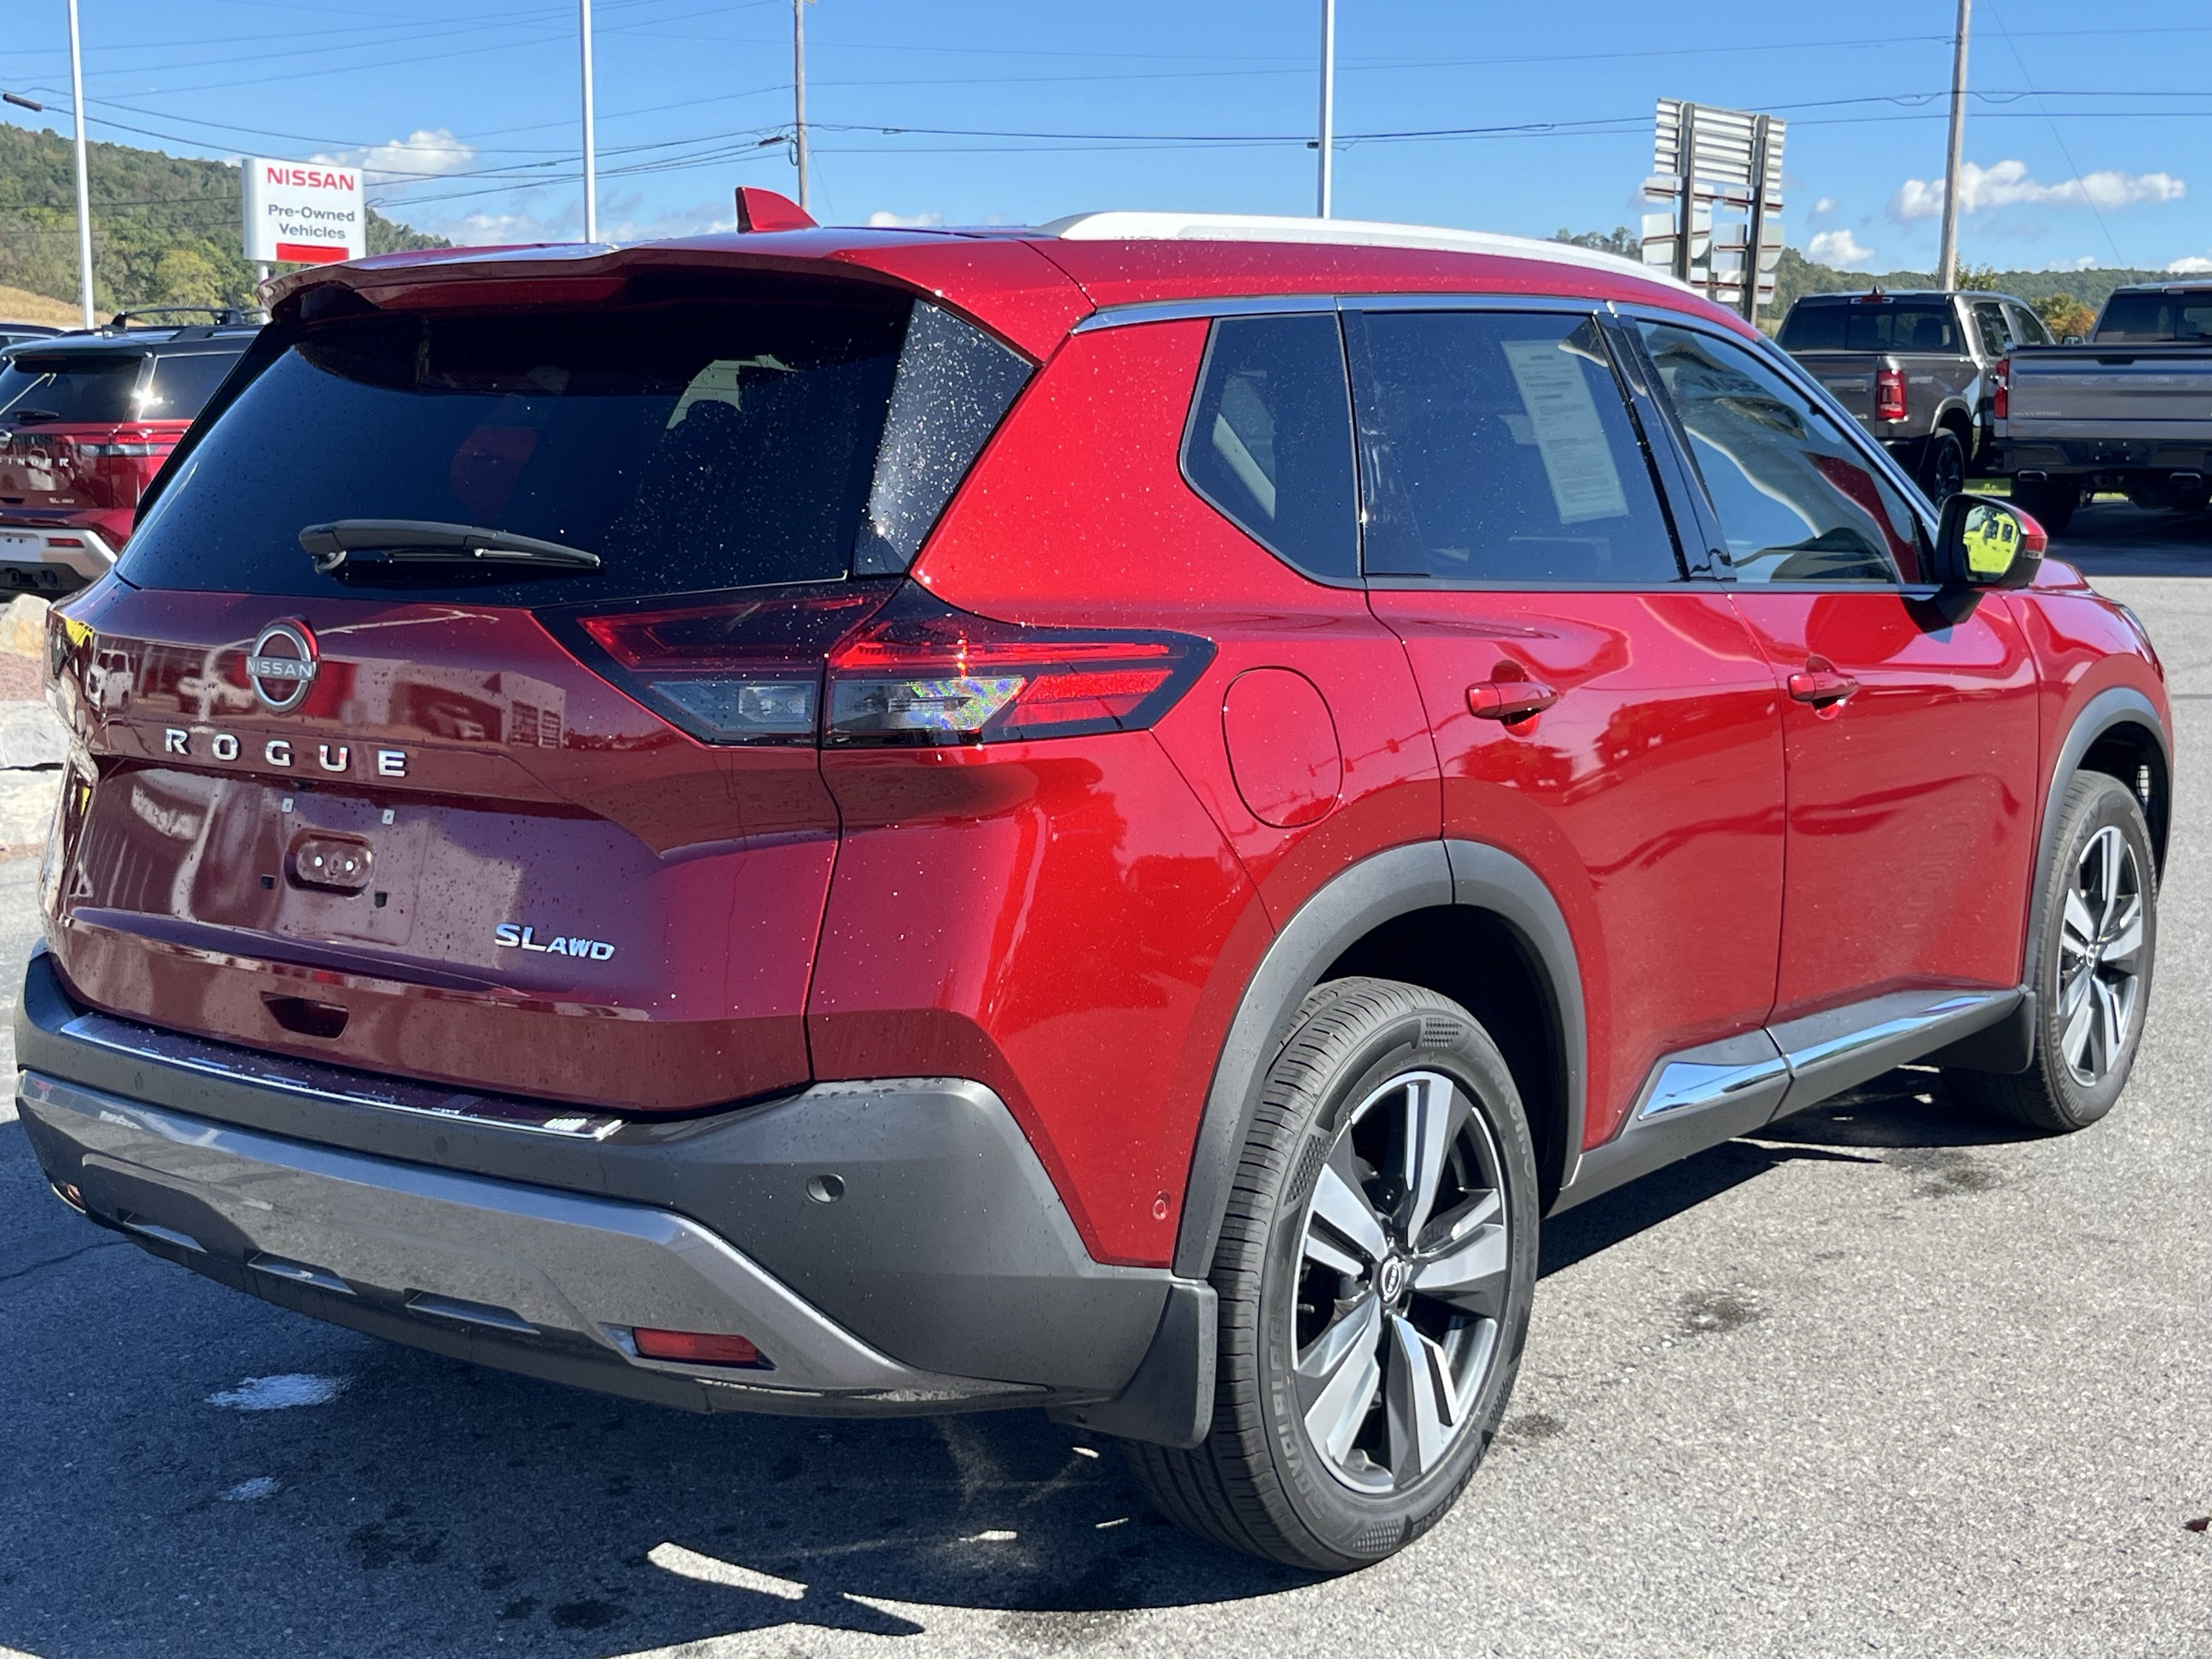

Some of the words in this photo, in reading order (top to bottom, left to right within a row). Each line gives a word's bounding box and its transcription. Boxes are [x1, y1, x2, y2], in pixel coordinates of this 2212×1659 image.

[267, 167, 354, 191] NISSAN
[268, 204, 355, 222] Pre-Owned
[279, 223, 346, 239] Vehicles
[247, 659, 313, 678] NISSAN
[166, 728, 407, 777] ROGUE
